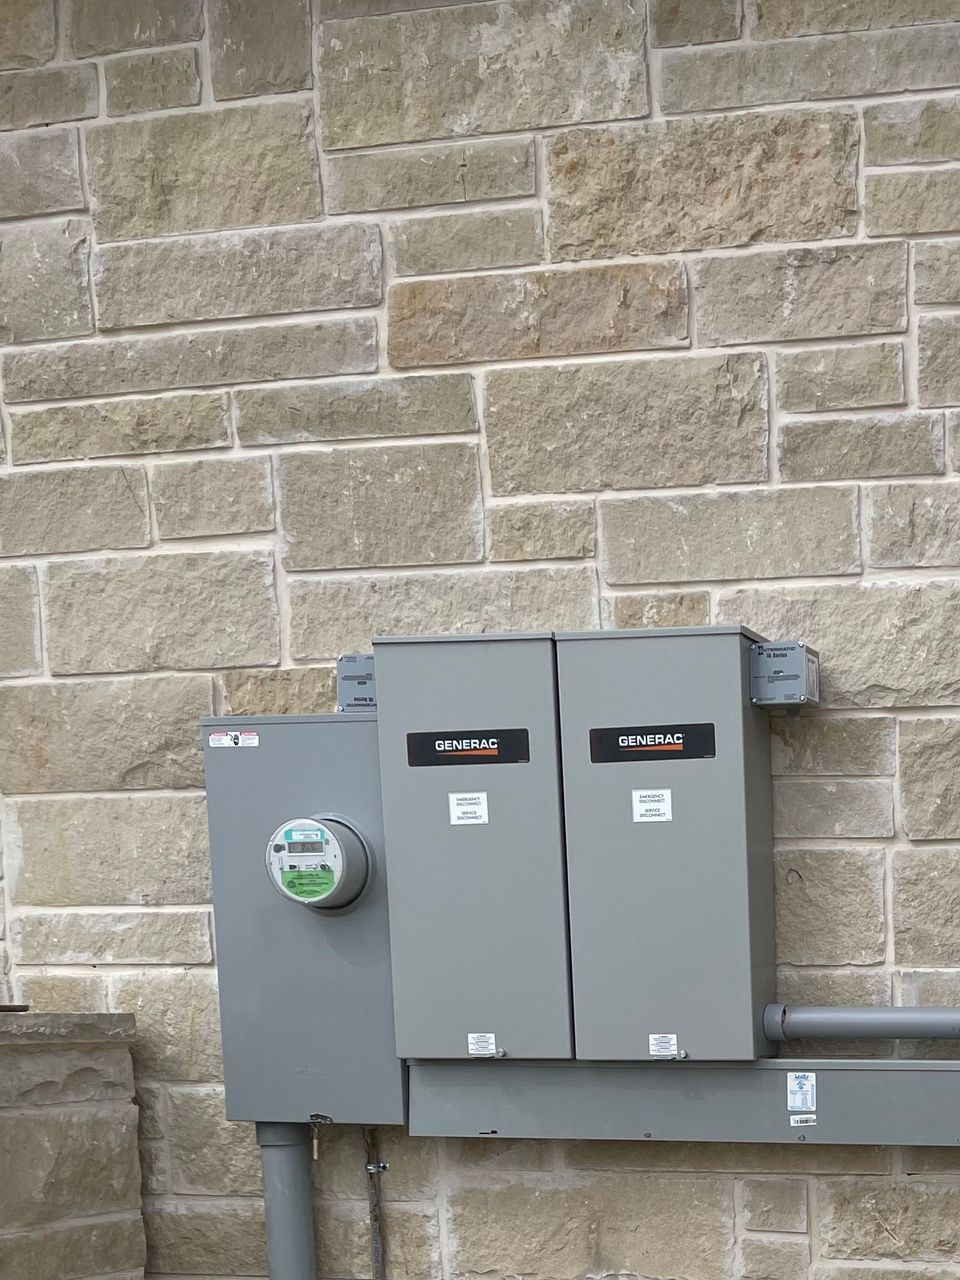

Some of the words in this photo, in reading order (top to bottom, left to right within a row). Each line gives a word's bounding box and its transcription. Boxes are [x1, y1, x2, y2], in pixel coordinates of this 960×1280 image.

[757, 645, 797, 656] INTERMATIC
[435, 739, 497, 750] GENERAC
[618, 734, 683, 746] GENERAC
